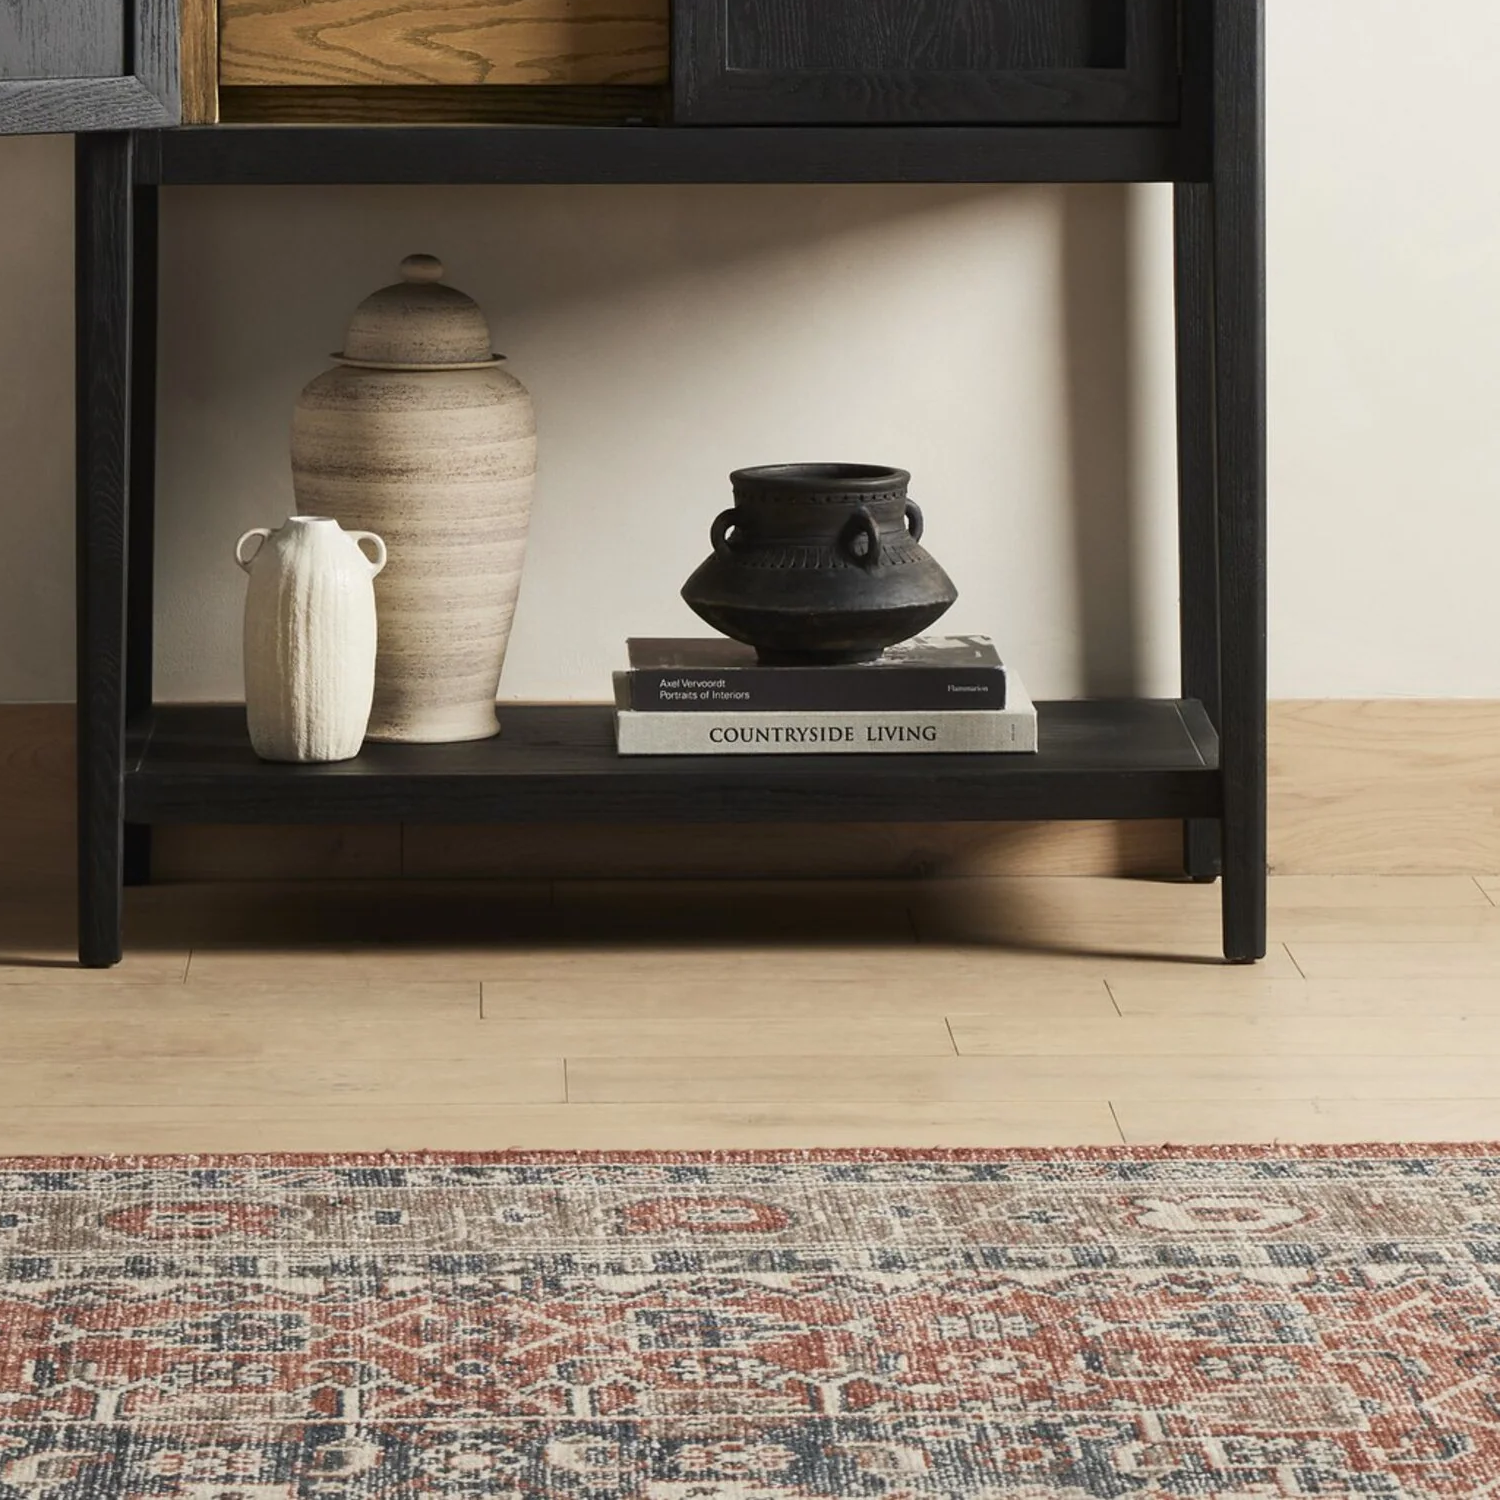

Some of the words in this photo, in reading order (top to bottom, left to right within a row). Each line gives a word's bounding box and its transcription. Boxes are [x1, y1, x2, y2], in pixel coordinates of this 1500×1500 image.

[659, 678, 680, 688] Axel
[681, 678, 726, 688] Vervoordt
[659, 690, 698, 700] Portraits
[700, 690, 710, 700] of
[712, 690, 751, 700] Interiors
[709, 726, 854, 743] COUNTRYSIDE
[867, 725, 937, 742] LIVING
